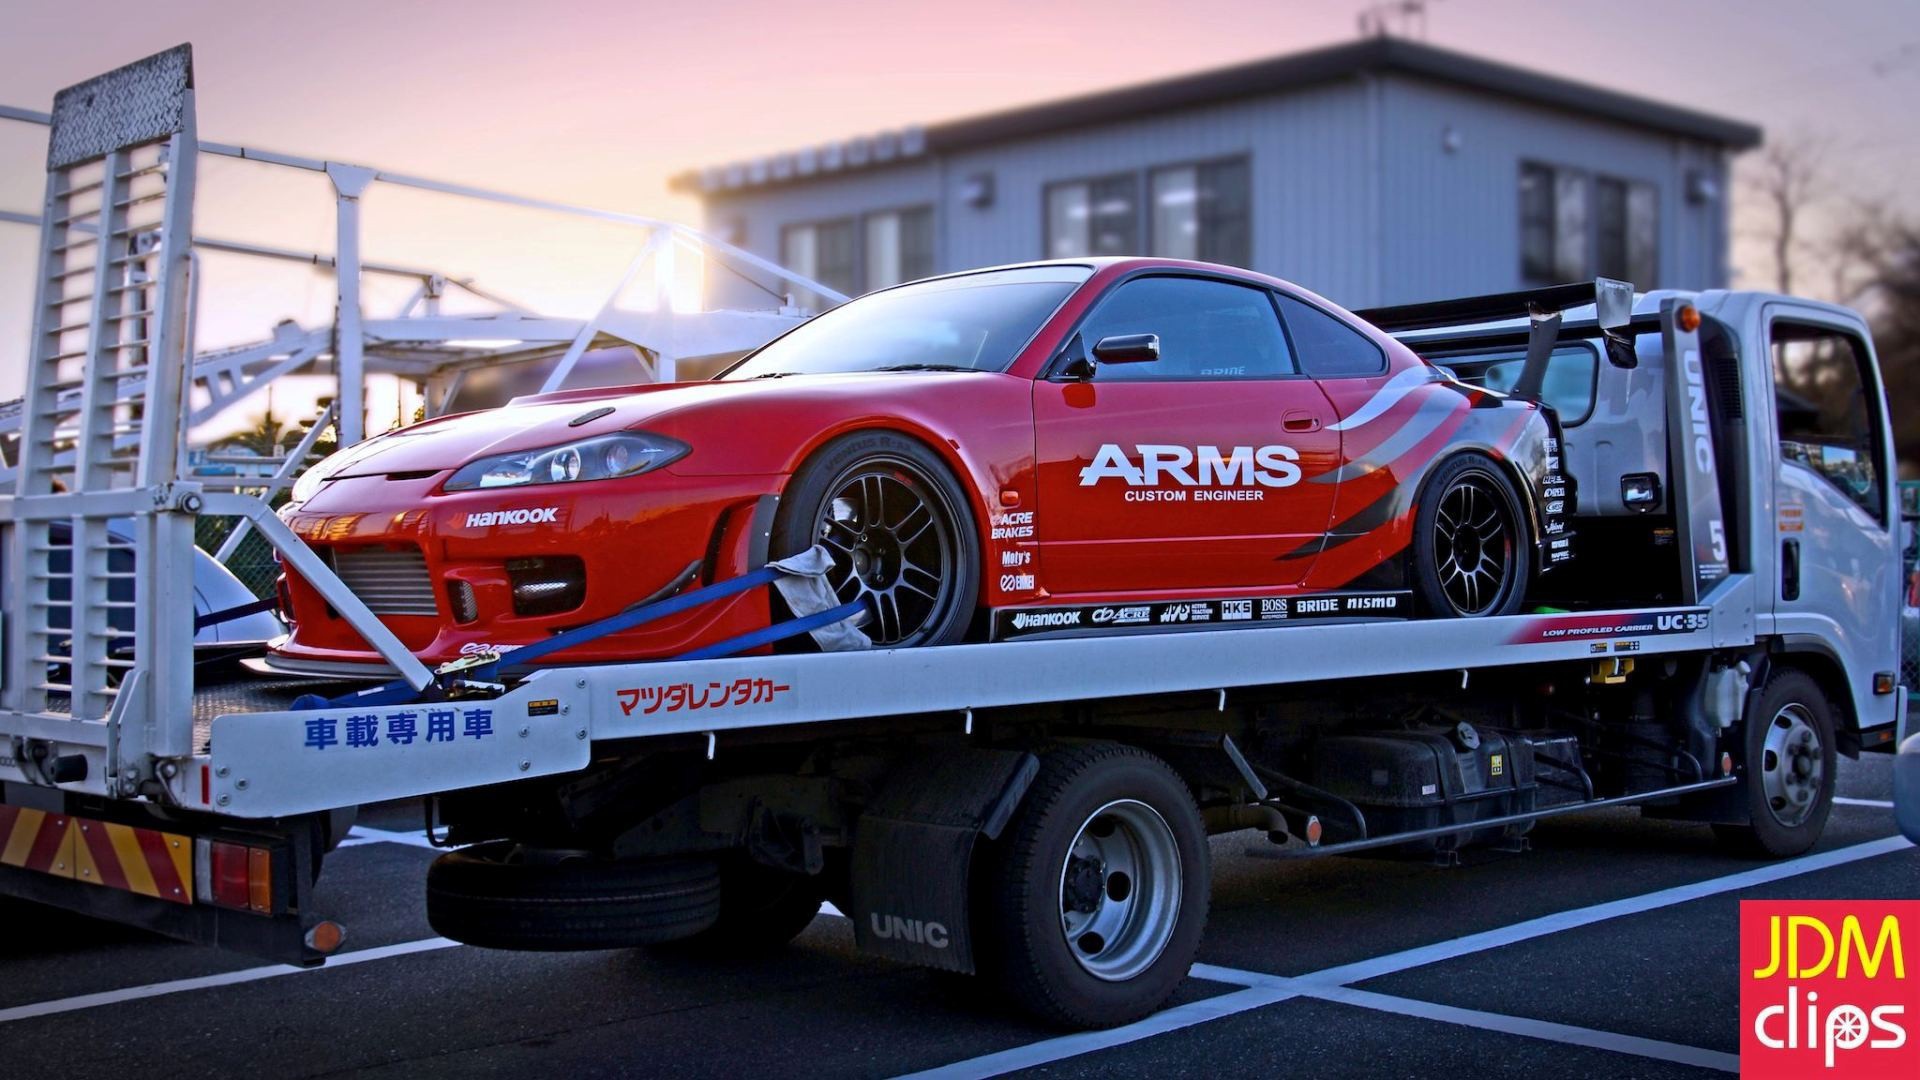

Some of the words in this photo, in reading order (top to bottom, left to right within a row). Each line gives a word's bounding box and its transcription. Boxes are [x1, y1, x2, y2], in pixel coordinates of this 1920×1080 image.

[1683, 350, 1712, 474] UNIC
[1079, 444, 1302, 487] ARMS
[1125, 490, 1186, 501] CUSTOM
[1194, 490, 1264, 501] ENGINEER
[1001, 512, 1033, 525] ACRE
[991, 526, 1033, 539] BRAKES
[1709, 520, 1726, 561] 5
[1002, 551, 1031, 567] Moty's
[1223, 602, 1251, 615] HKS
[1261, 599, 1287, 611] BOSS
[1297, 599, 1339, 613] BRIDE
[1567, 626, 1613, 635] PROFILED
[1614, 625, 1653, 633] CARRIER
[616, 678, 791, 717] マツダレンタカー
[304, 708, 494, 751] 車載専用車
[870, 912, 949, 949] UNIC
